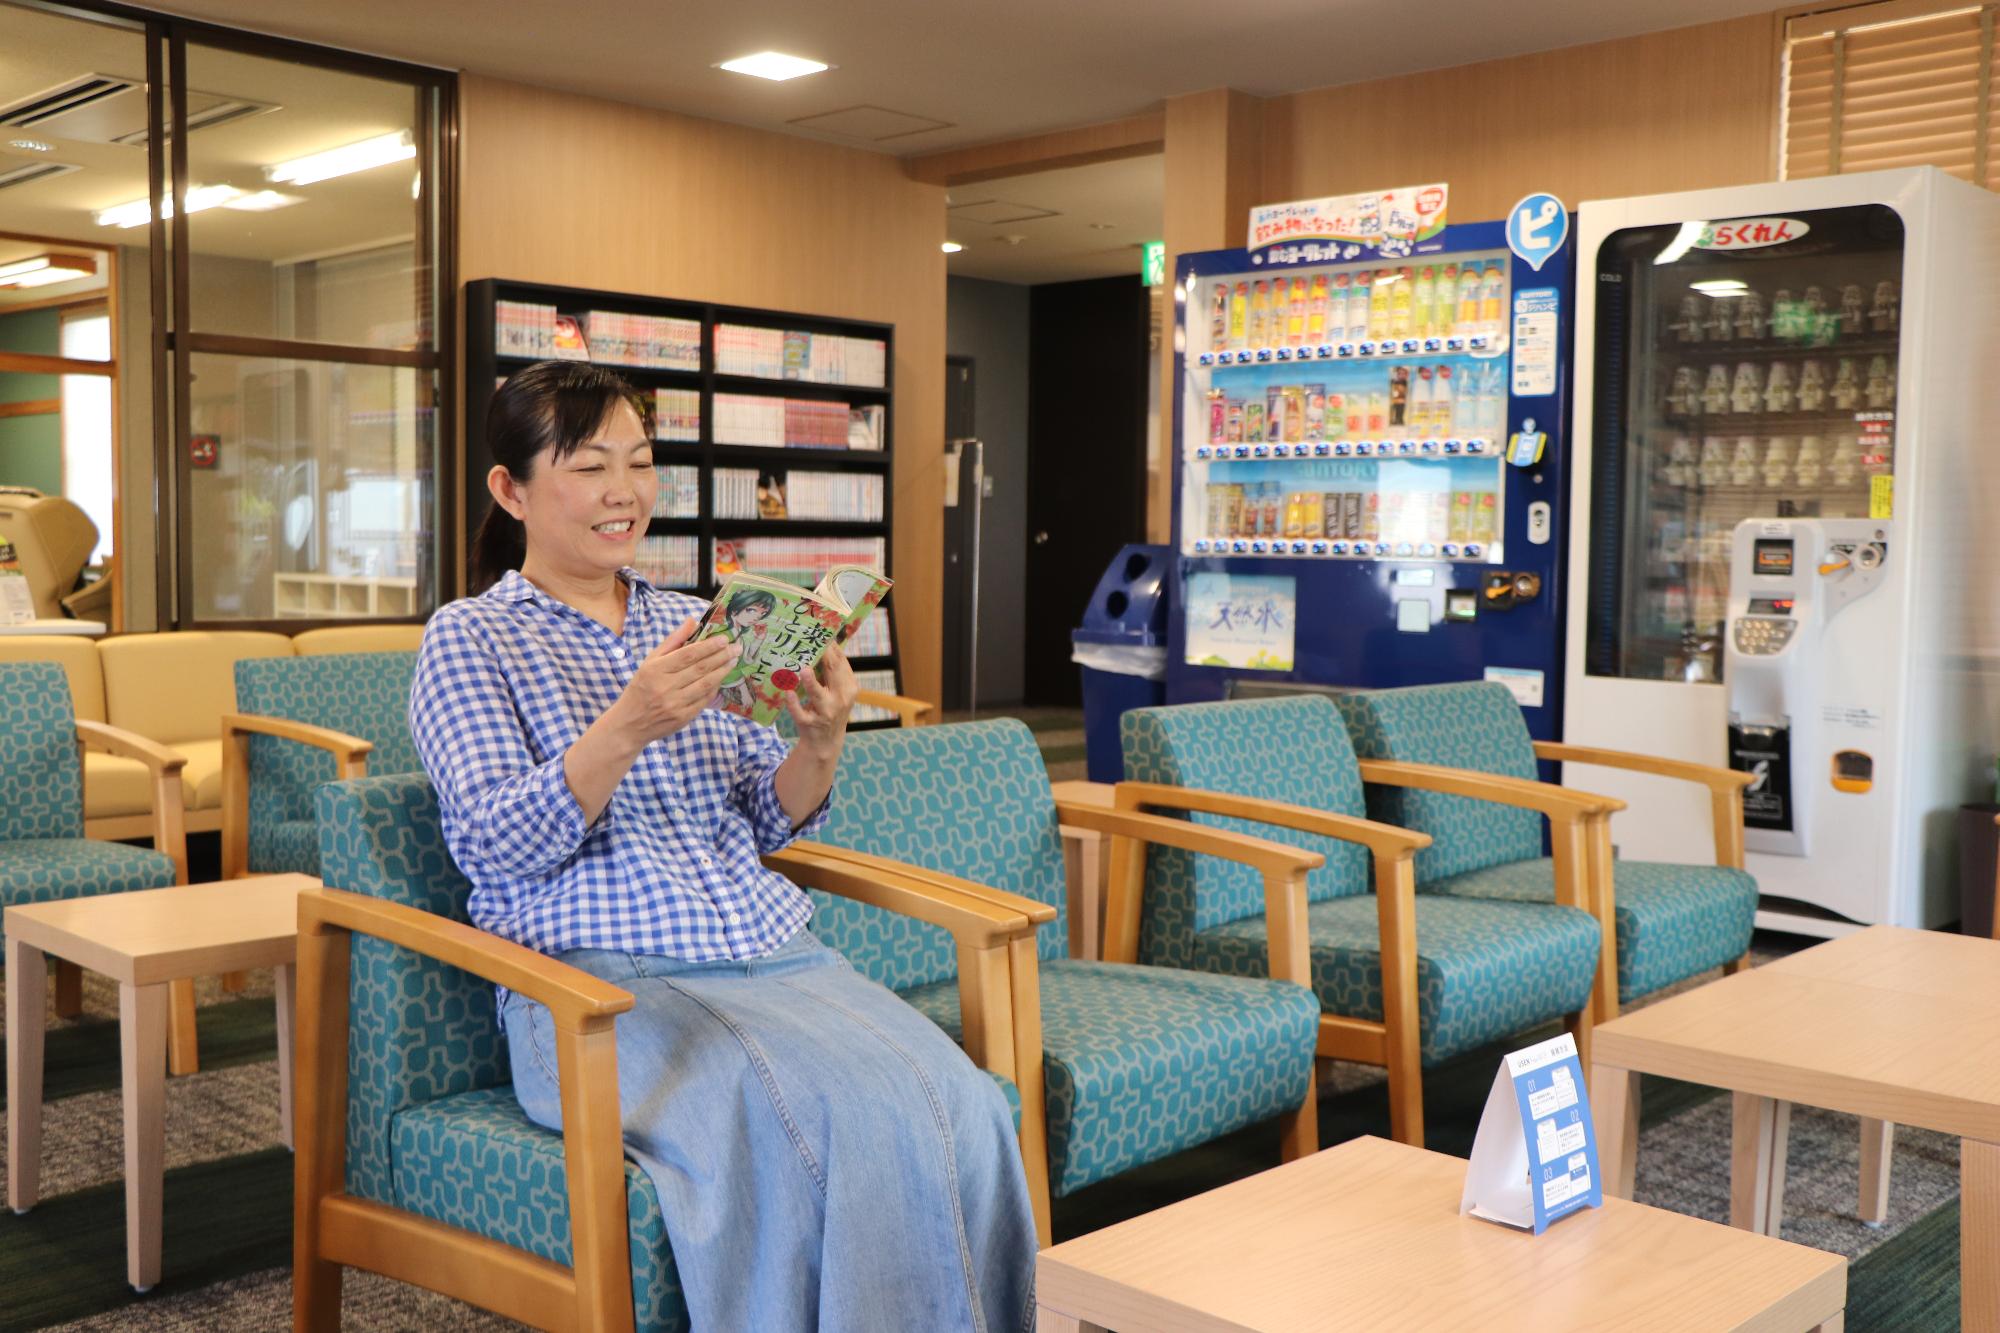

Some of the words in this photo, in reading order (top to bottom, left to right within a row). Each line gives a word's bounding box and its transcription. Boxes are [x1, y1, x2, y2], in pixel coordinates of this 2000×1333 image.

[1519, 201, 1559, 250] ピ
[1715, 221, 1793, 246] らくれん
[1210, 600, 1284, 633] 天然水
[1527, 1079, 1537, 1093] 01
[1570, 1109, 1581, 1122] 02
[1543, 1167, 1553, 1180] 03
